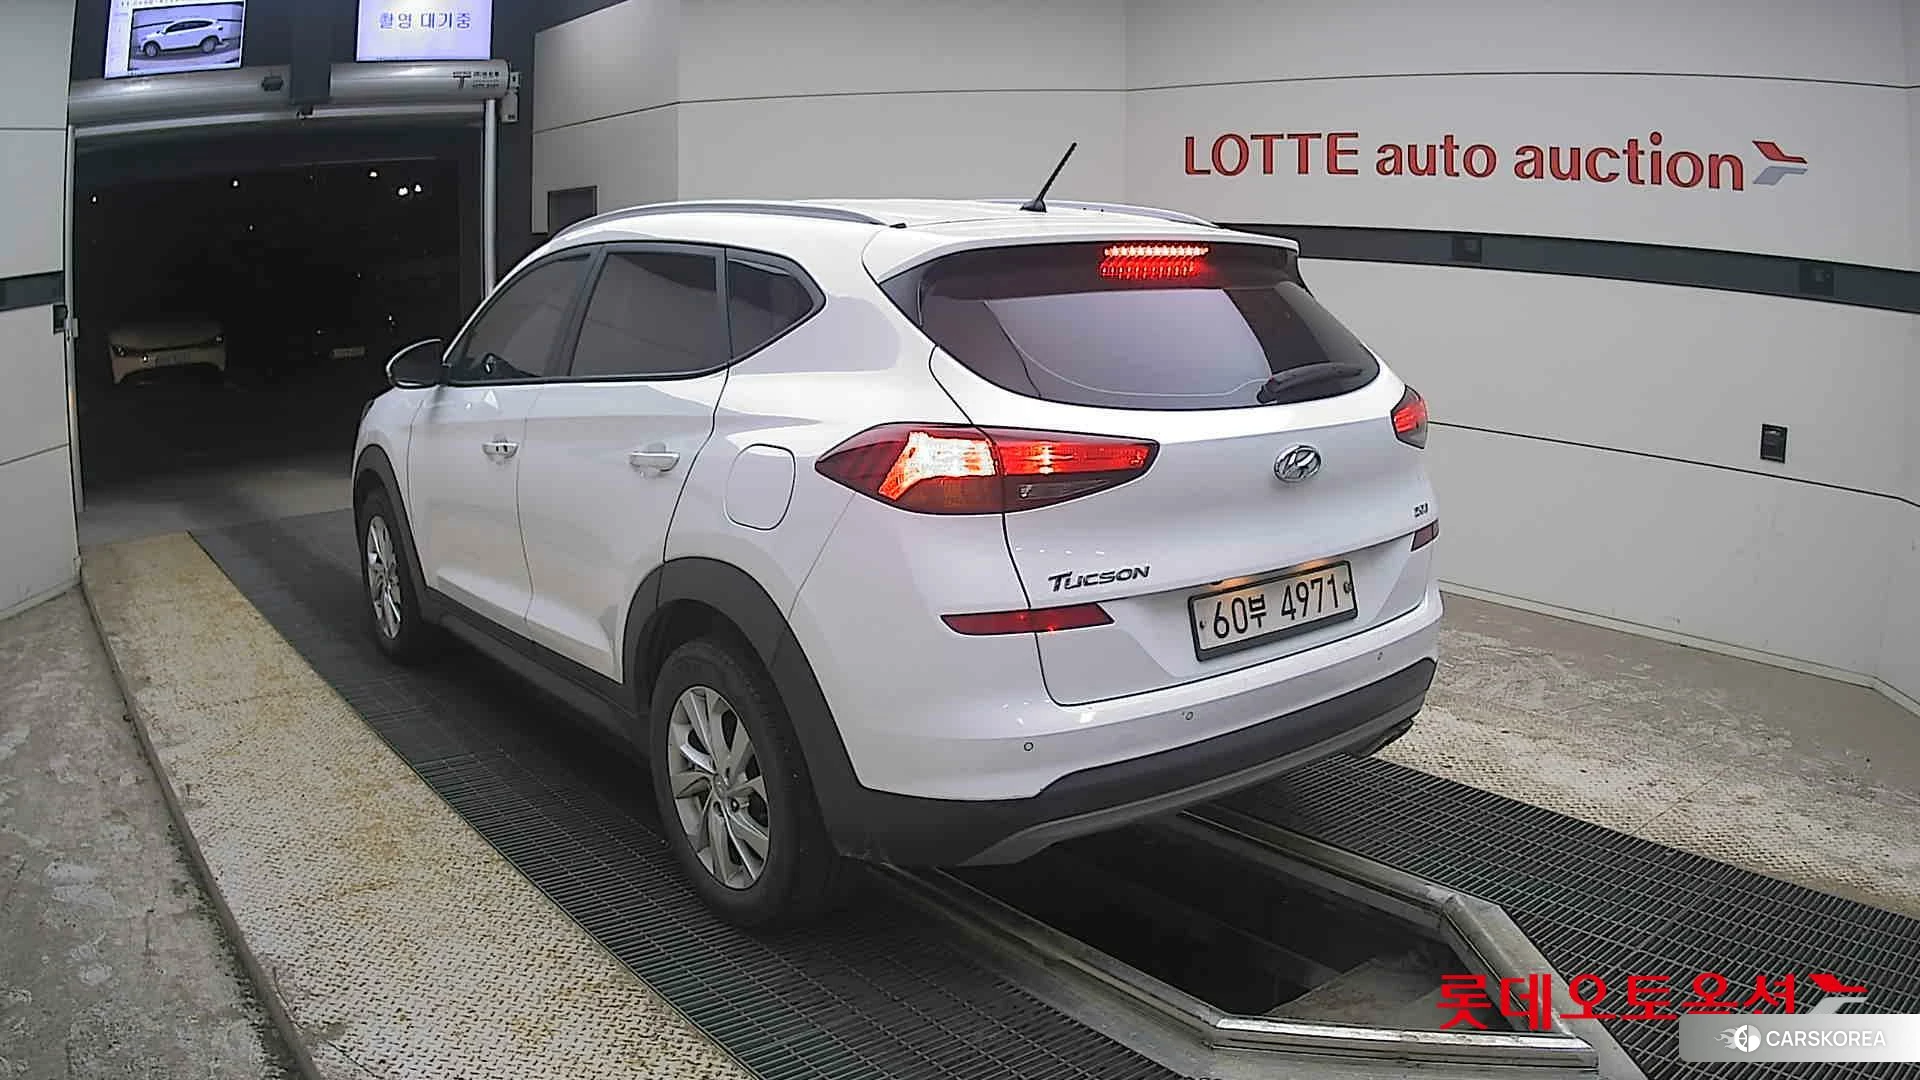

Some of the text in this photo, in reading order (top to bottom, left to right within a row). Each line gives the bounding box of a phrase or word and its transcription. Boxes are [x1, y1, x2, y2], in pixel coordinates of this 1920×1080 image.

[420, 12, 471, 29] 대기중
[1184, 131, 1745, 192] LOTTE auto auction
[1213, 573, 1339, 639] 60부 4971
